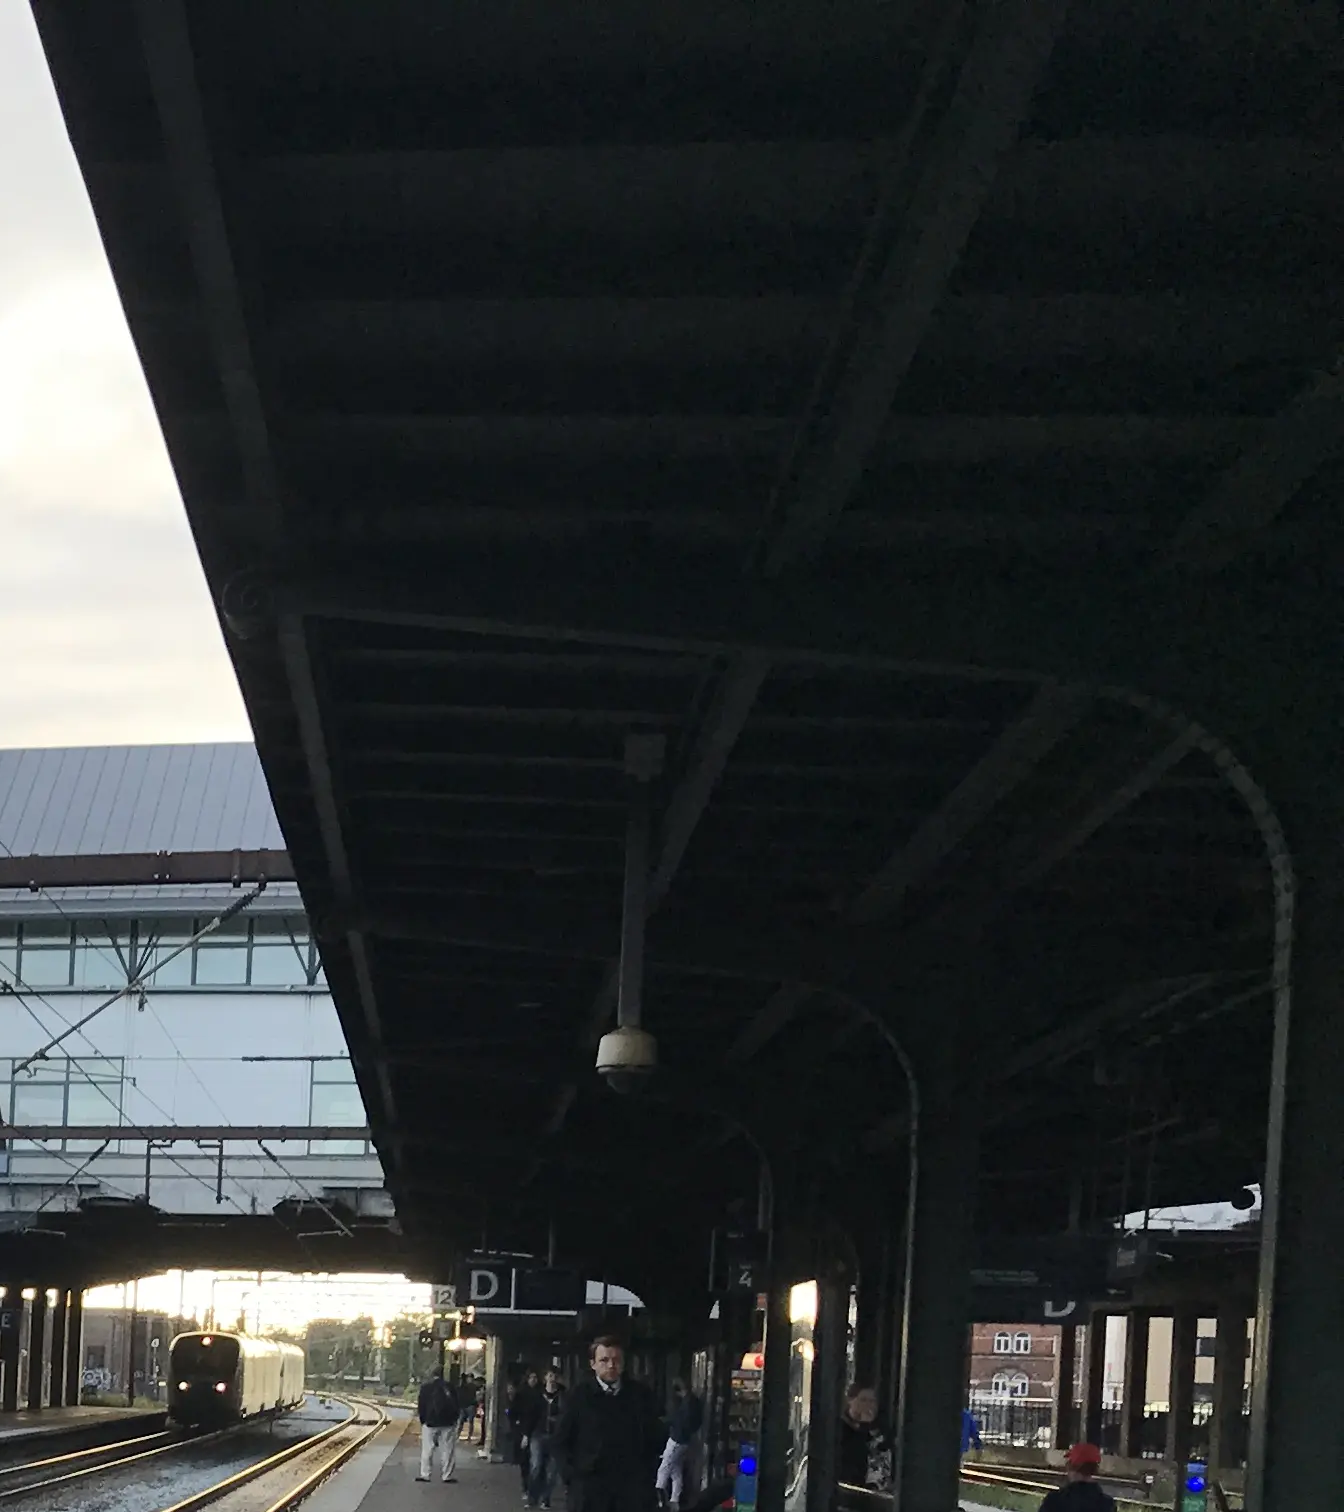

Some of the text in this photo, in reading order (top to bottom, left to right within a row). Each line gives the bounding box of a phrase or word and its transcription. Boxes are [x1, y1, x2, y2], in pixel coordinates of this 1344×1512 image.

[470, 1269, 499, 1300] D
[738, 1271, 752, 1288] 4
[434, 1290, 451, 1306] 12
